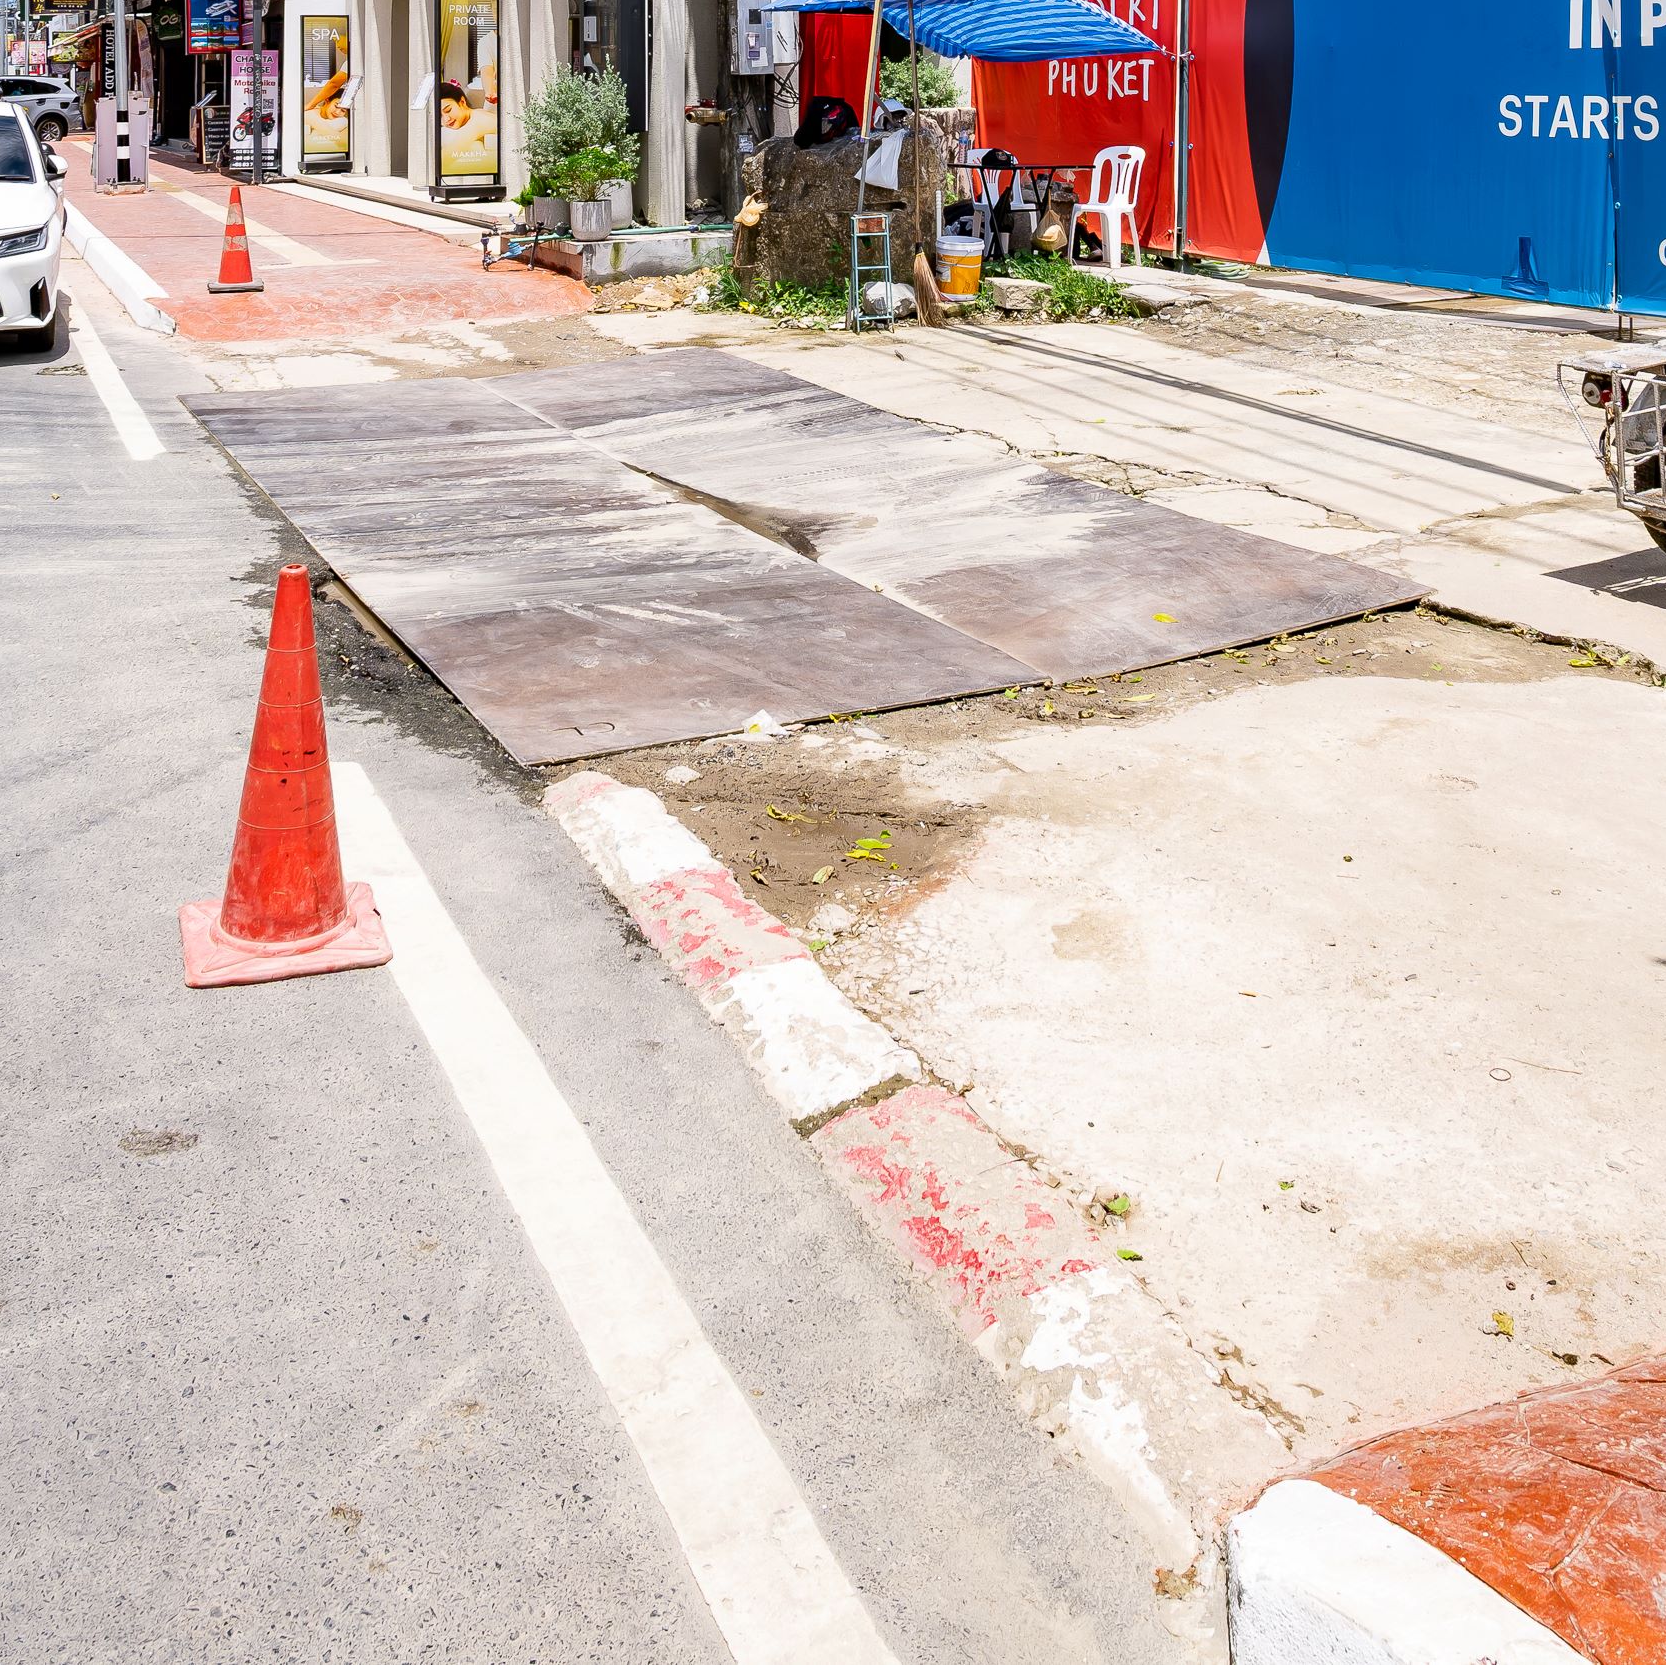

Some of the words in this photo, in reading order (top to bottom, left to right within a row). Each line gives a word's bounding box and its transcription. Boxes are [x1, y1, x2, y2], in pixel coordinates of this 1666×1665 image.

[449, 4, 491, 14] PRIVATE
[453, 16, 485, 26] ROOM
[312, 28, 340, 40] SPA
[105, 29, 115, 65] HOTEL
[1048, 59, 1155, 102] PHUKET
[1498, 94, 1660, 142] STARTS
